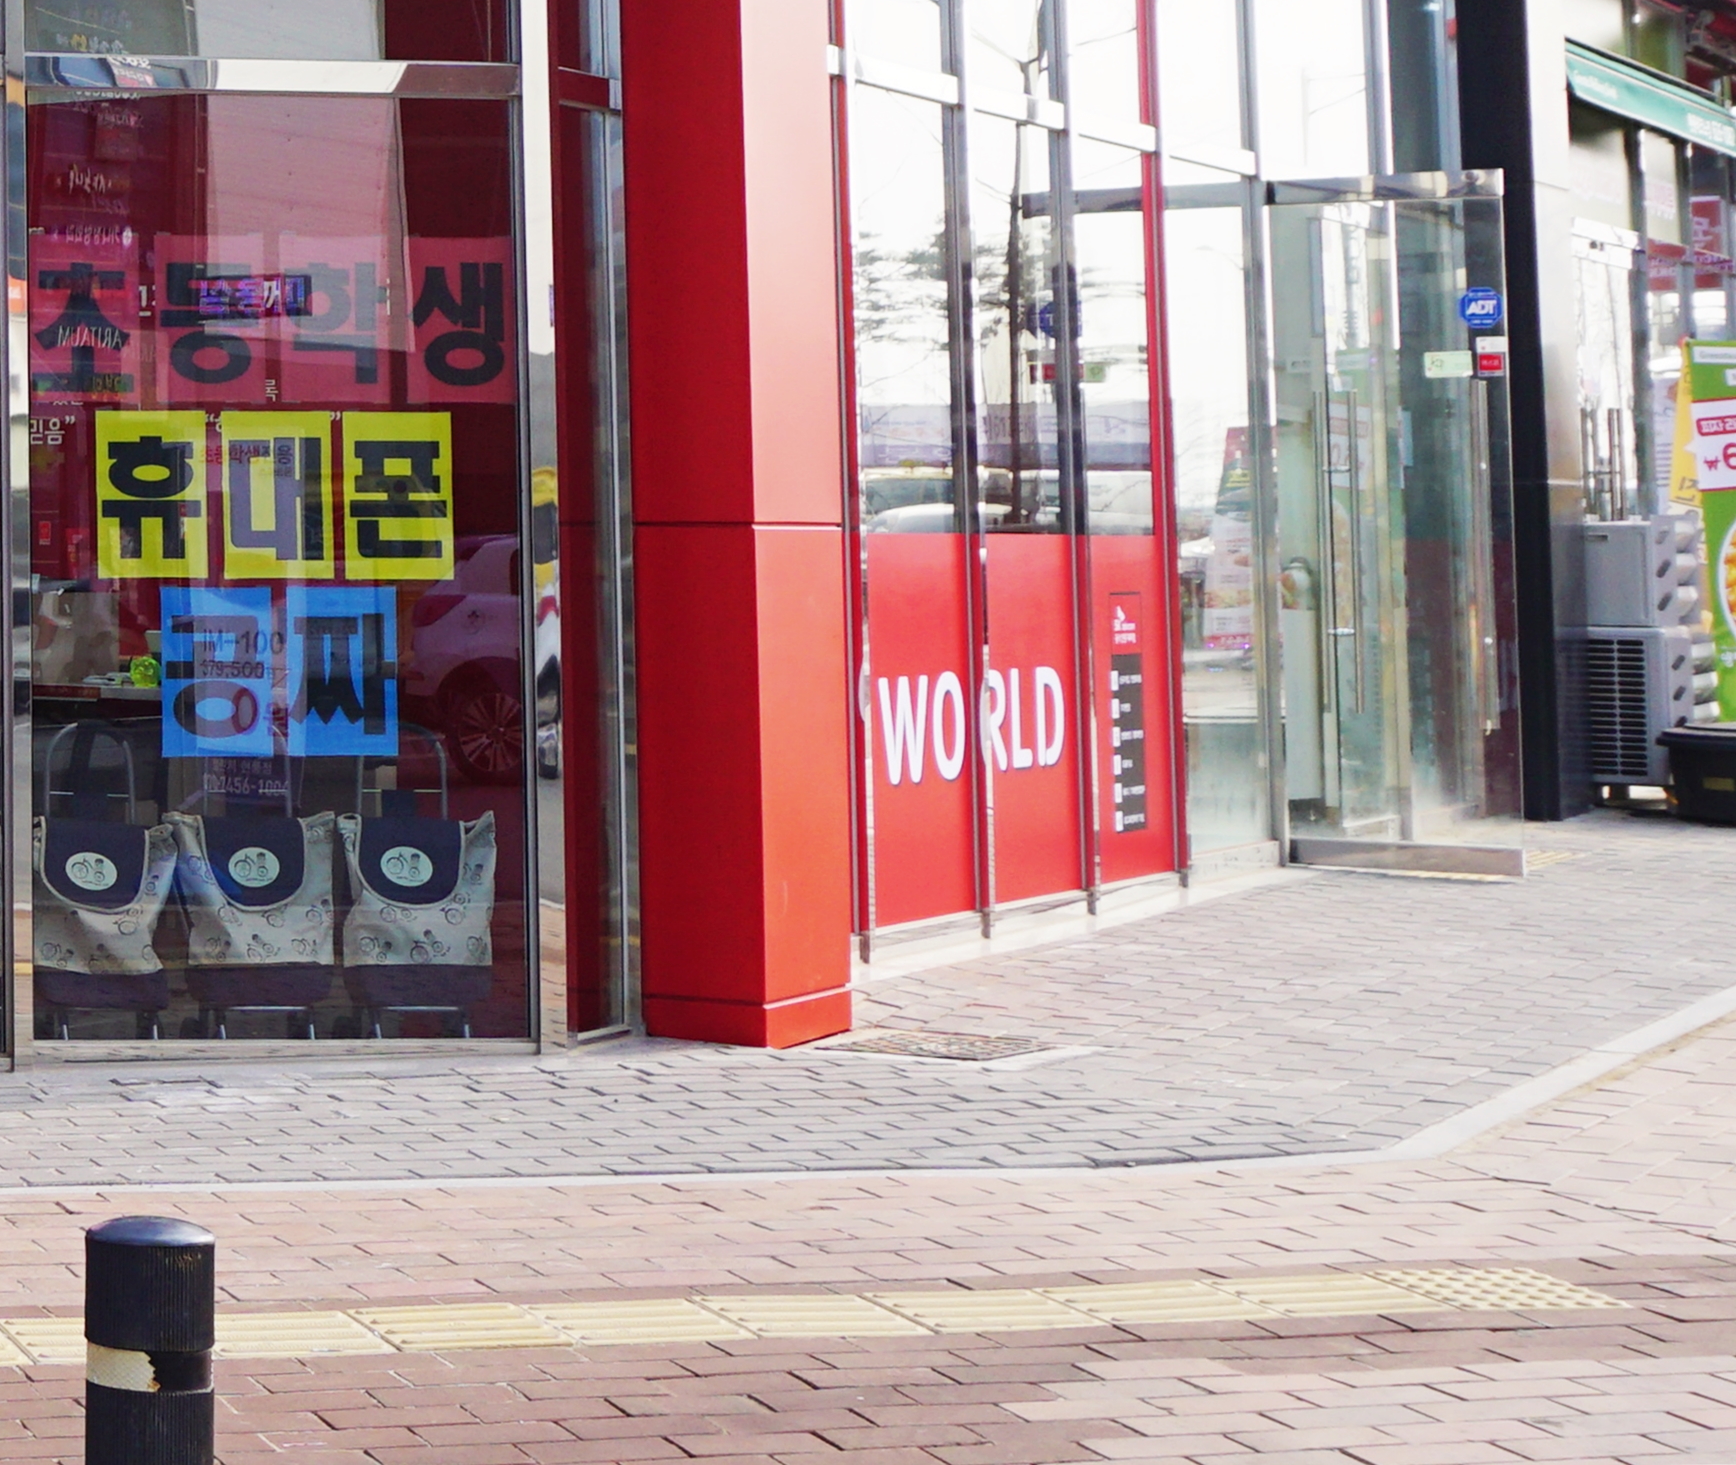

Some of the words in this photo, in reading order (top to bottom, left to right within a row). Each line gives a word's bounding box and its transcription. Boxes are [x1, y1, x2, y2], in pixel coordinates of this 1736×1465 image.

[31, 260, 506, 395] 초등학생
[1466, 299, 1498, 316] ADT
[101, 434, 450, 564] 휴대폰
[165, 612, 397, 738] 공짜
[877, 665, 1066, 786] WORLD
